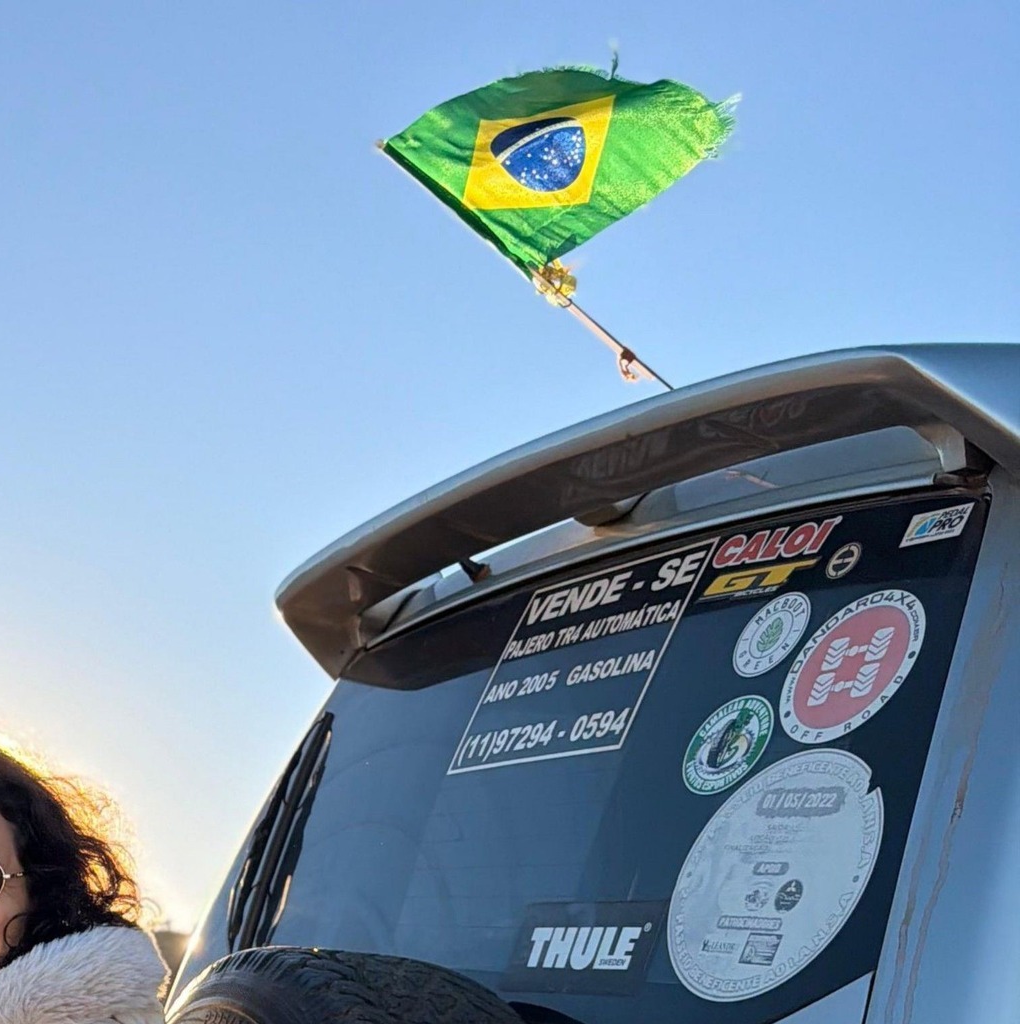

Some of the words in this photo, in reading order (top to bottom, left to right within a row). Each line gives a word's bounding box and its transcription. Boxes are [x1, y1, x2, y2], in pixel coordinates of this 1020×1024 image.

[712, 515, 843, 568] CALOI
[928, 515, 965, 533] PRO
[526, 571, 633, 625] VENDE
[650, 551, 707, 592] SE
[703, 557, 818, 596] GT
[504, 630, 555, 660] PAJERO
[555, 627, 580, 646] TR4
[580, 600, 681, 641] AUTOMÁTICA
[755, 598, 806, 626] MACBOOT
[483, 681, 518, 704] ANO
[517, 670, 560, 696] 2005
[566, 649, 656, 686] GASOLINA
[738, 642, 790, 670] GREEN
[790, 724, 823, 741] OFF
[843, 675, 904, 732] ROAD
[457, 720, 558, 767] (11)97294
[569, 707, 631, 742] 0594
[762, 792, 838, 809] 01/05/2022
[526, 926, 642, 971] THULE
[598, 958, 627, 967] SWEDEN
